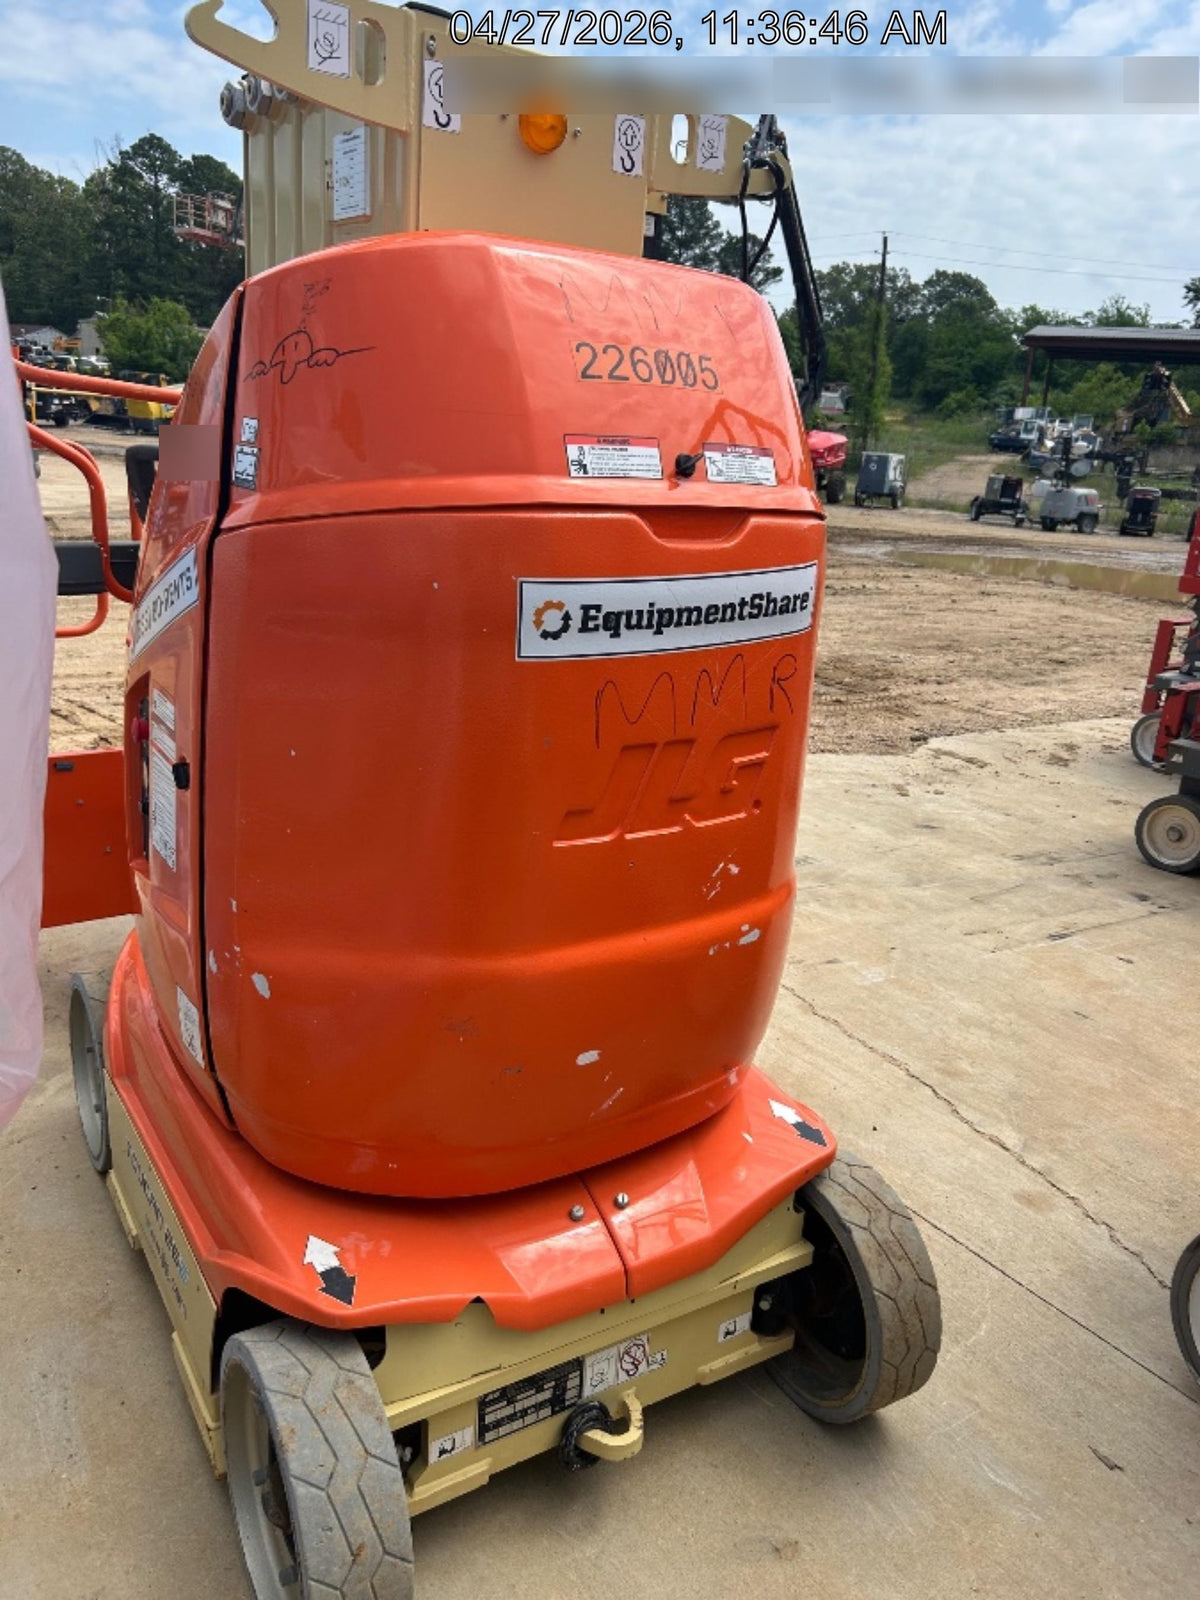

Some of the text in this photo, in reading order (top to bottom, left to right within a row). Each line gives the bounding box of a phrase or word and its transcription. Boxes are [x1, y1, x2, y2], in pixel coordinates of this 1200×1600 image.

[575, 341, 719, 391] 226005
[578, 590, 810, 639] EquipmentShare
[553, 723, 781, 849] JLG
